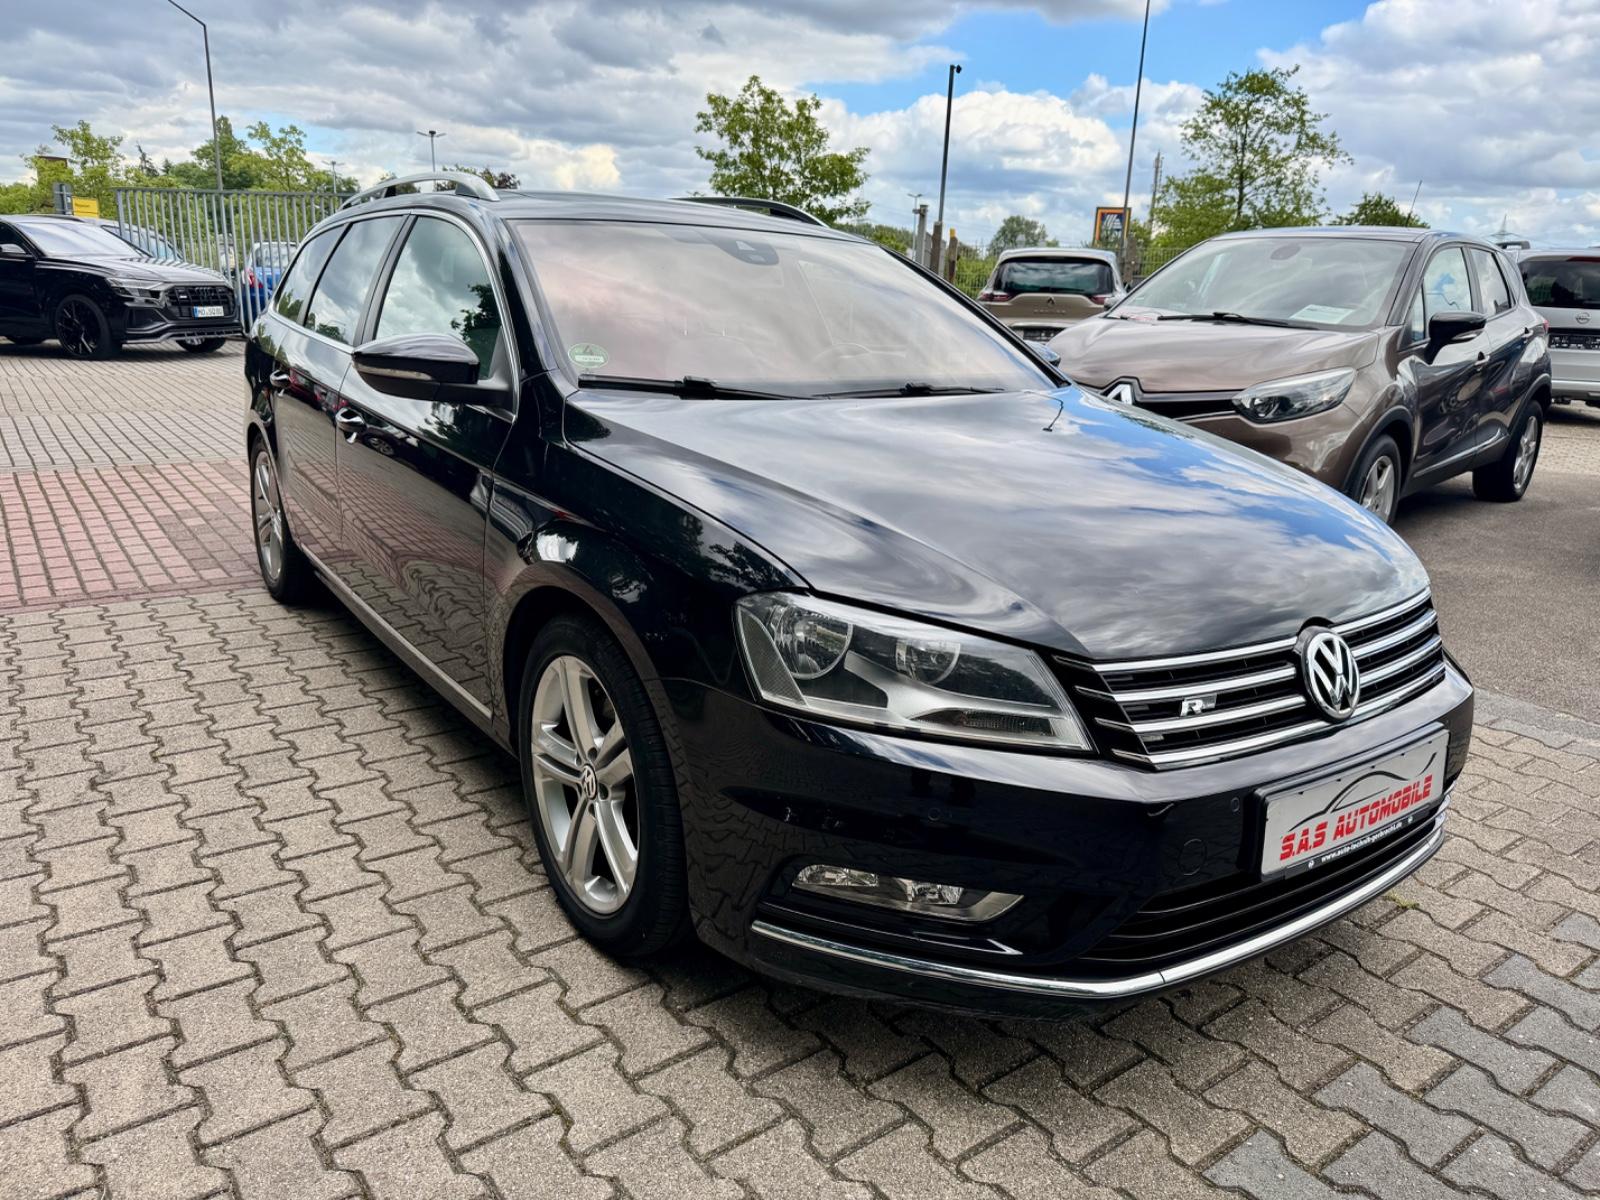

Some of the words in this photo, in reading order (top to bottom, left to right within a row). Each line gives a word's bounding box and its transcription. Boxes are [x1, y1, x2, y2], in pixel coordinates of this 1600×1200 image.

[1180, 699, 1203, 717] R
[1280, 820, 1328, 860] S.A.S
[1333, 774, 1433, 841] AUTOMOBILE
